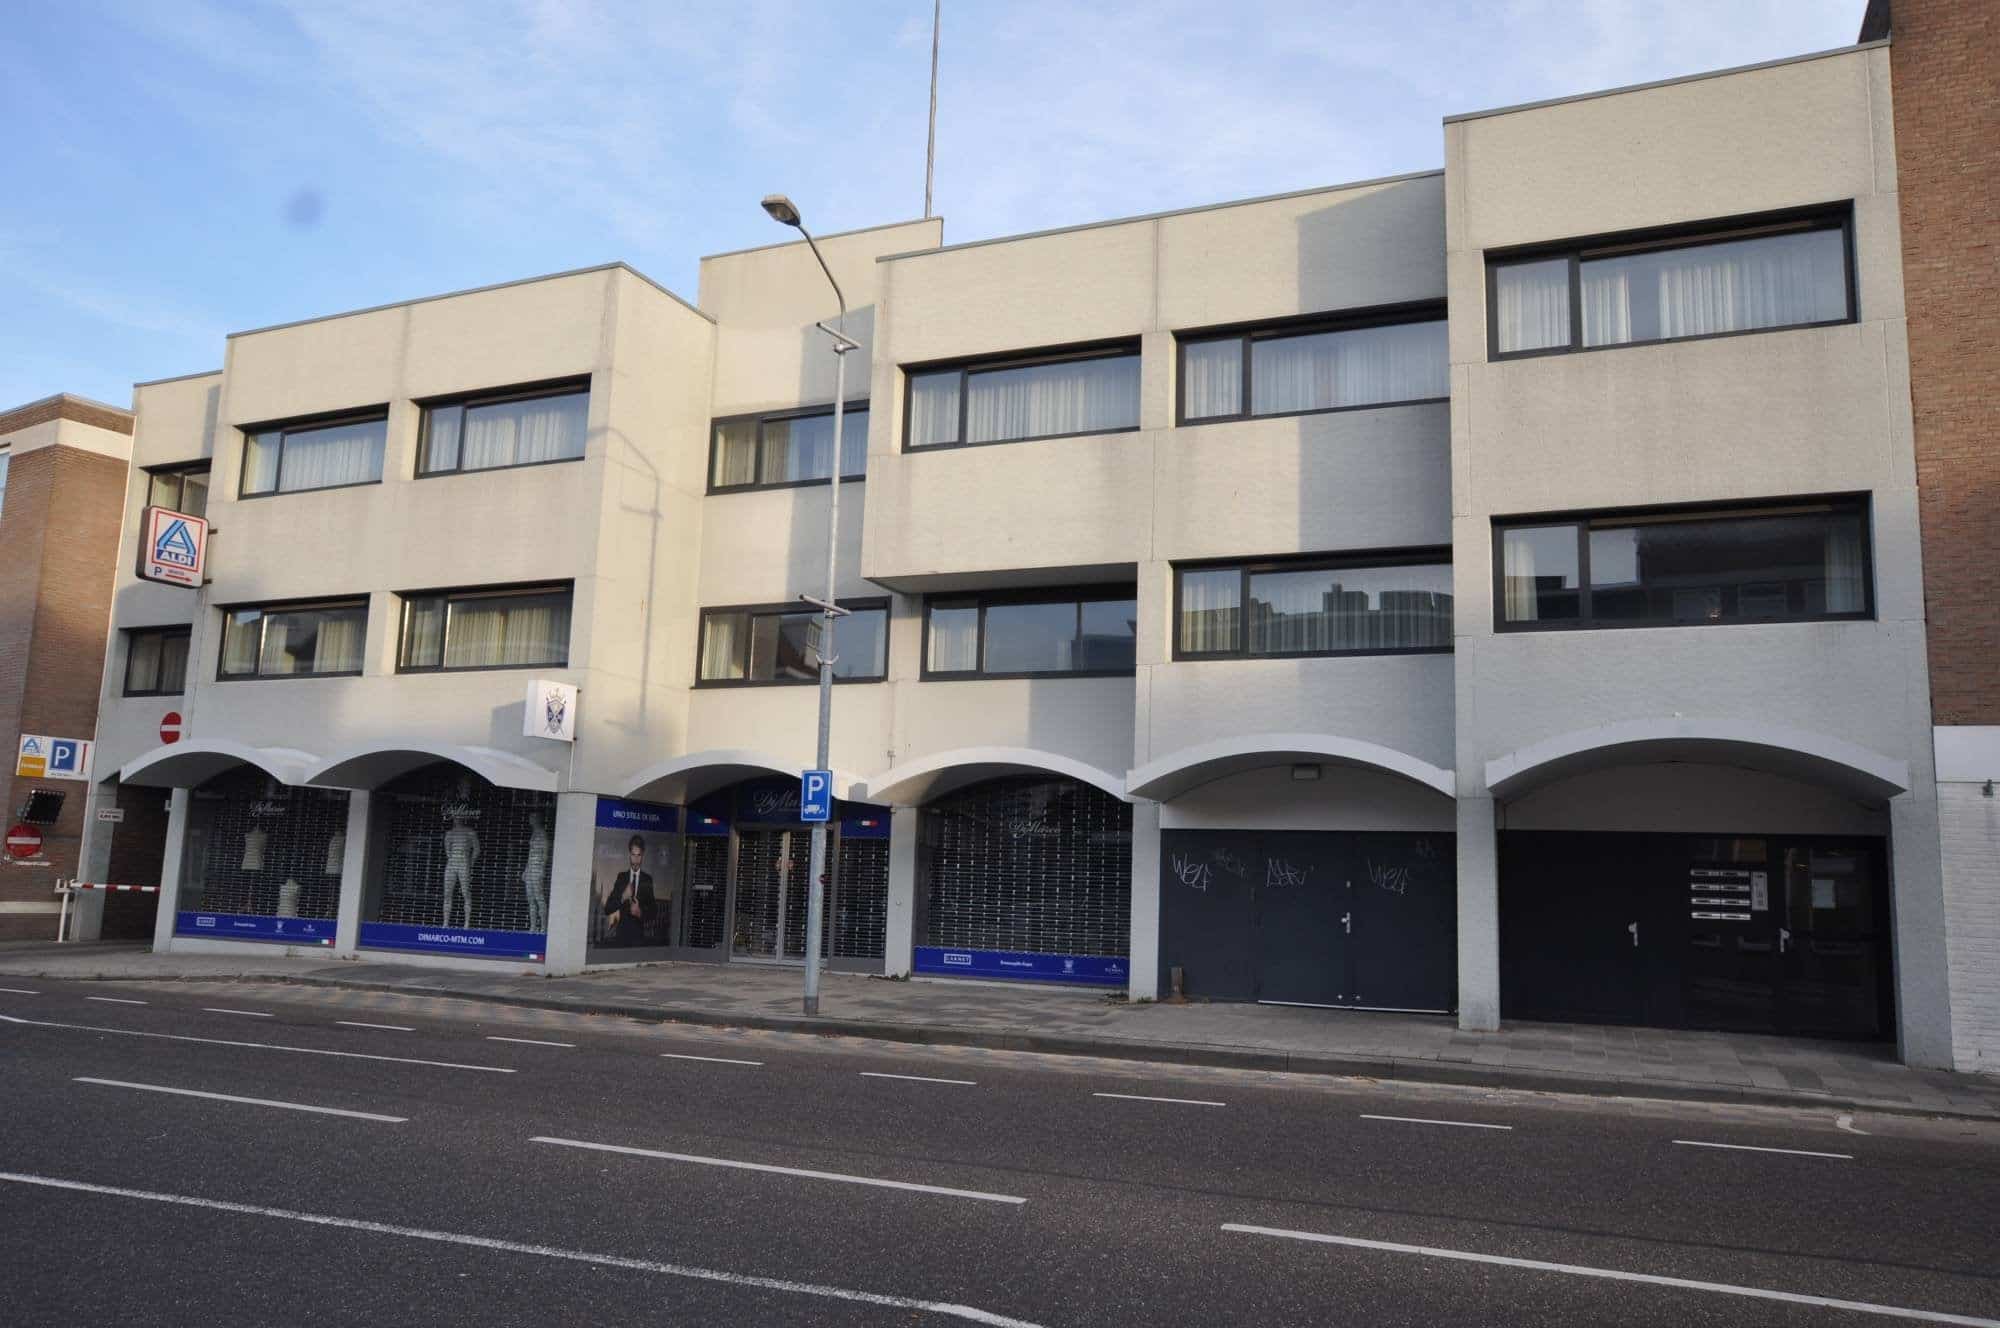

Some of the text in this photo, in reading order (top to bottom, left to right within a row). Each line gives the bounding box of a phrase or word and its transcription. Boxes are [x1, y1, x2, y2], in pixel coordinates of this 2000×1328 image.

[159, 551, 193, 566] ALDI
[54, 746, 70, 767] P
[808, 775, 824, 801] P
[417, 933, 485, 945] DIMARCO-MTM.COM
